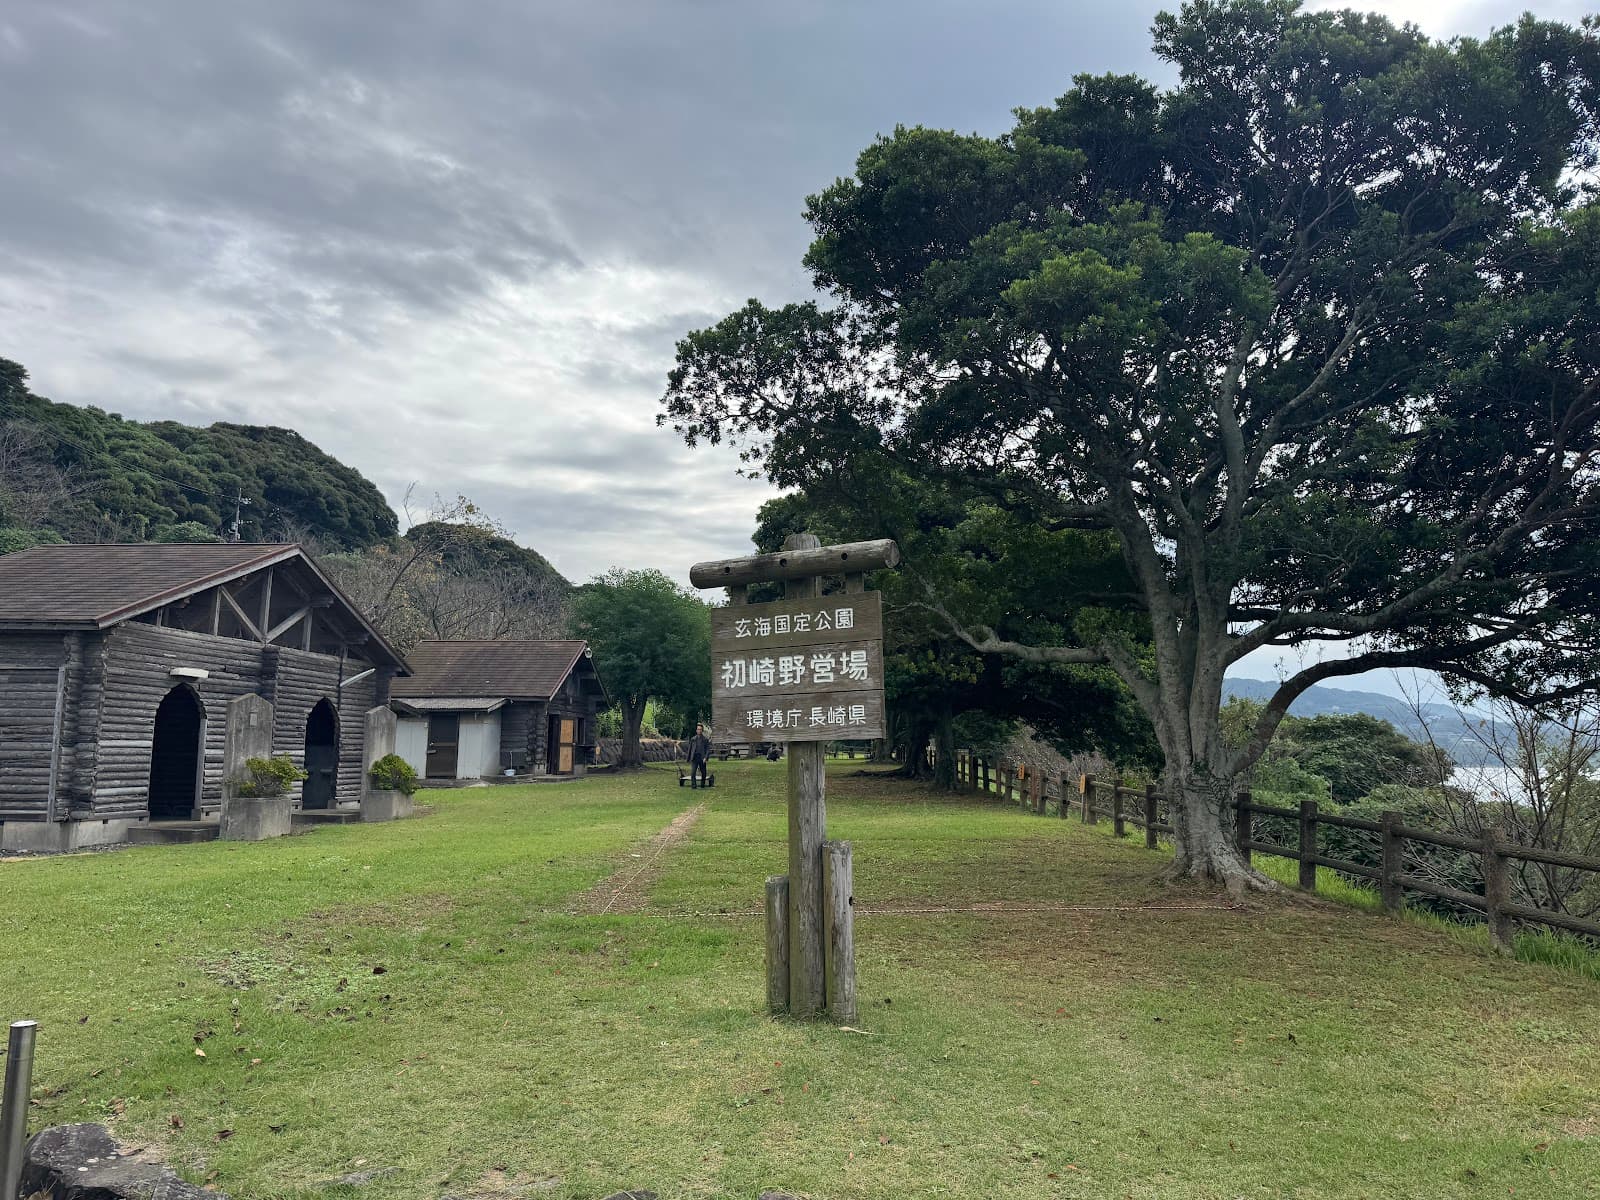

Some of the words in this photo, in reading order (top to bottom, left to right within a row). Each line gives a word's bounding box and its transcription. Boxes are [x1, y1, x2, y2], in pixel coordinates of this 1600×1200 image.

[735, 608, 854, 638] 玄海国定公園
[721, 650, 869, 689] 初崎野営場
